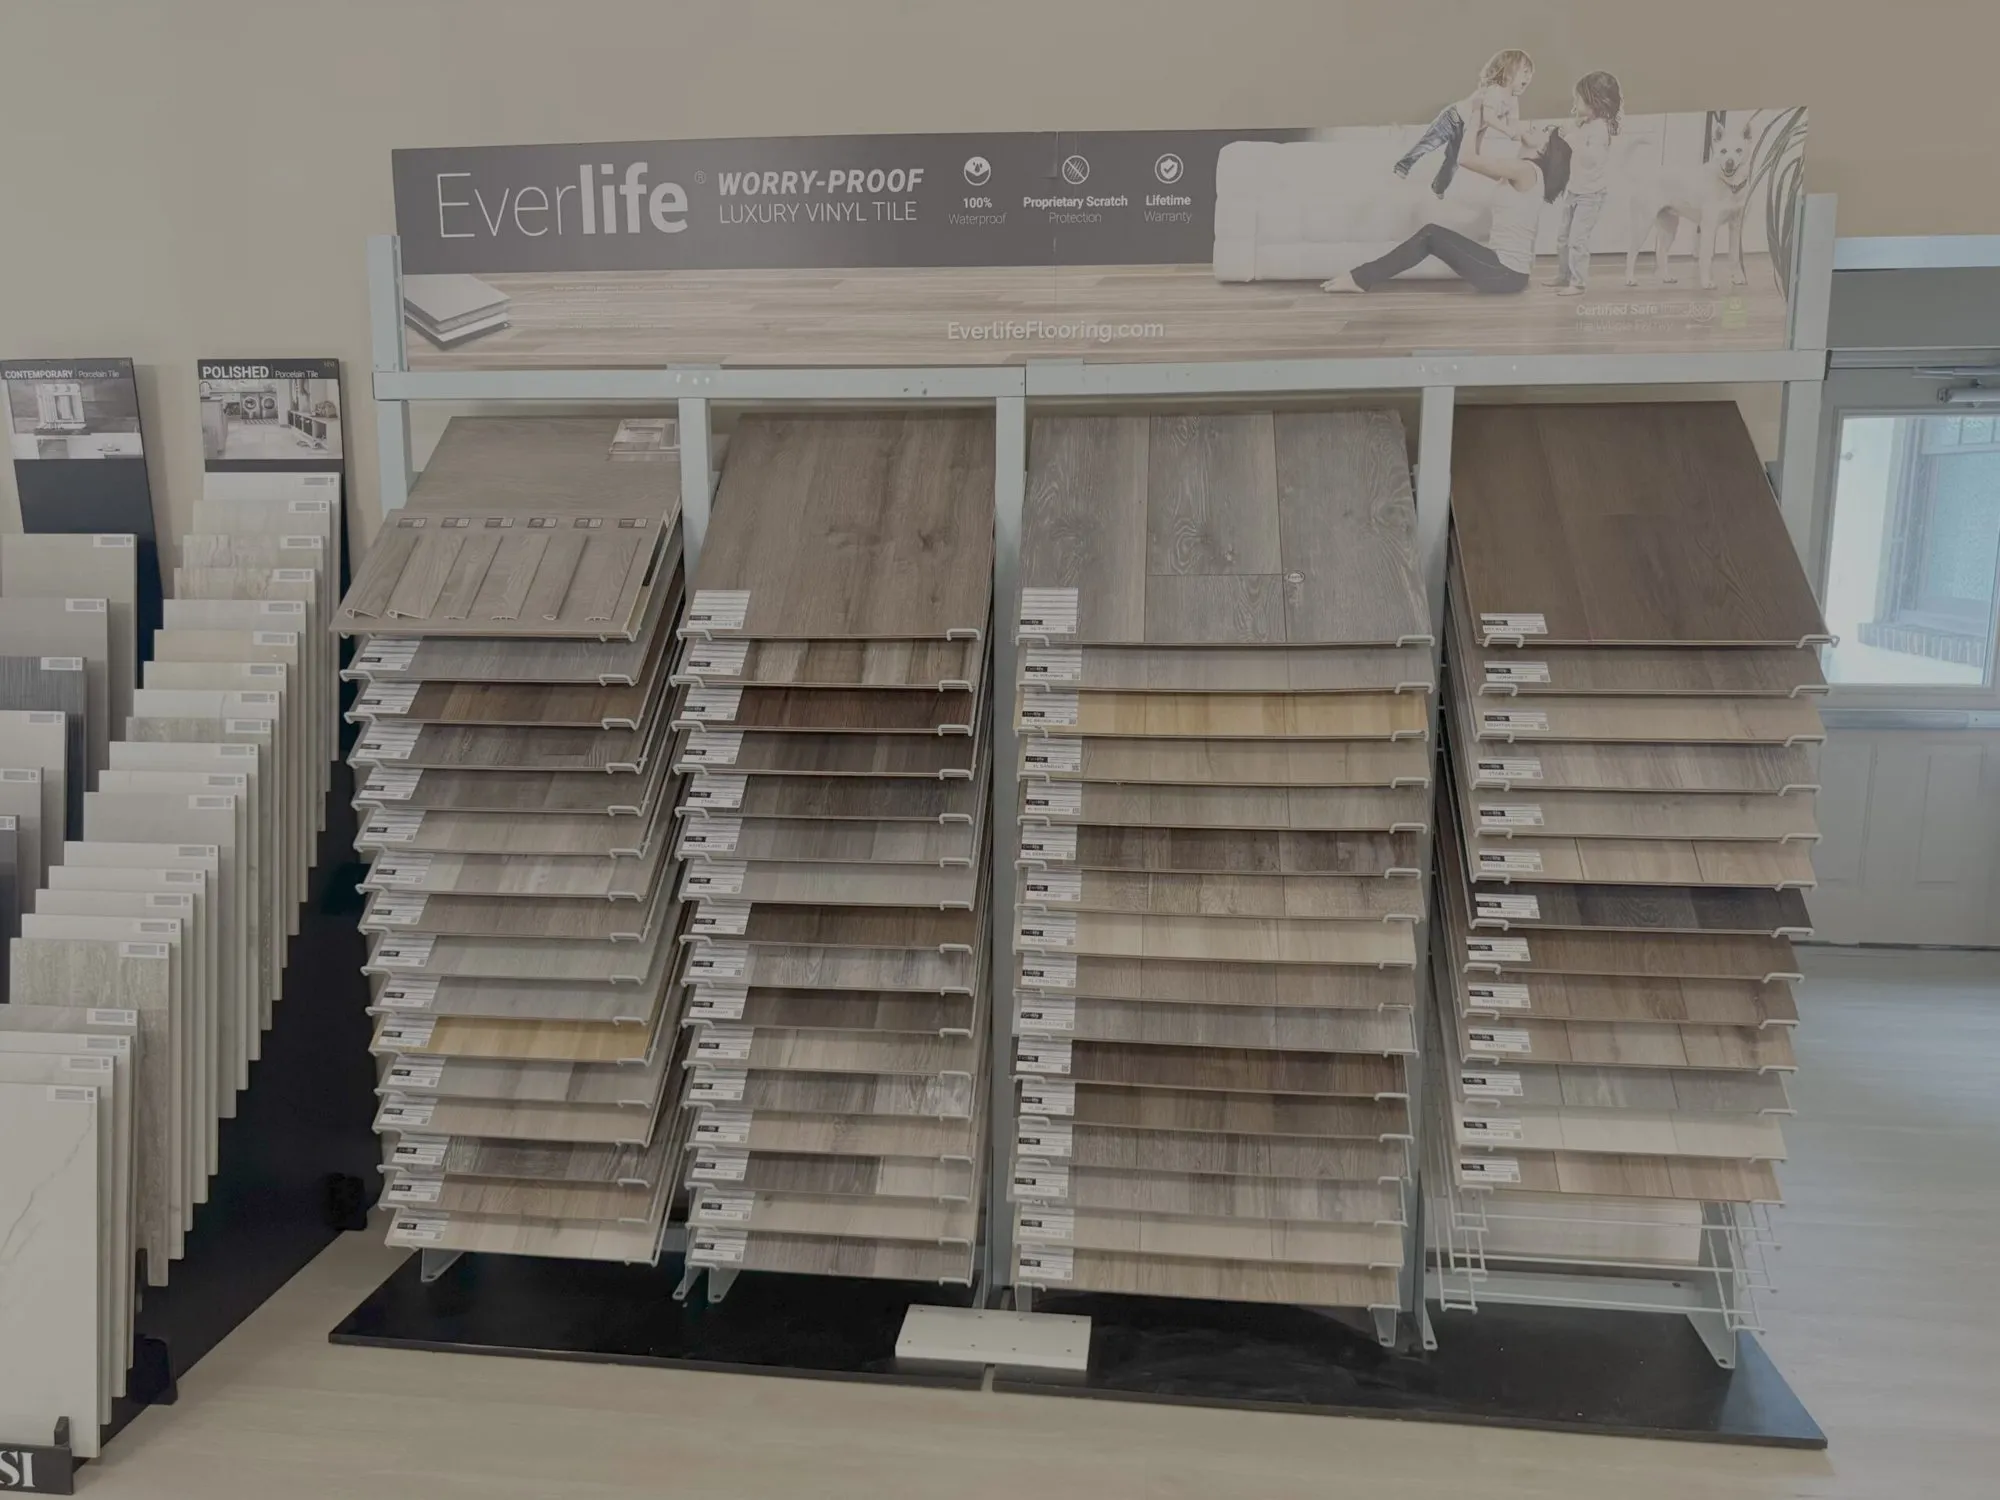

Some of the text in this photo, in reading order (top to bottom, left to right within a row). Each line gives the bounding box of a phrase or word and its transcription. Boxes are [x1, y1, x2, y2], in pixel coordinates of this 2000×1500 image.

[718, 168, 925, 197] WORRY-PROOF
[437, 161, 689, 239] Everlife
[962, 196, 993, 210] 100%
[1023, 195, 1129, 211] Proprietary Scratch
[1145, 194, 1192, 207] Lifetime
[719, 200, 918, 226] LUXURY VINYL TILE
[948, 212, 1007, 226] Waterproof
[1048, 210, 1102, 225] Protection
[1143, 210, 1193, 225] Warranty
[1576, 303, 1628, 317] Certified
[1630, 302, 1659, 316] Safe
[947, 320, 1165, 343] EverlifeFlooring.com
[4, 369, 73, 379] CONTEMPORARY
[202, 365, 319, 379] POLISHED Porcelain Tile
